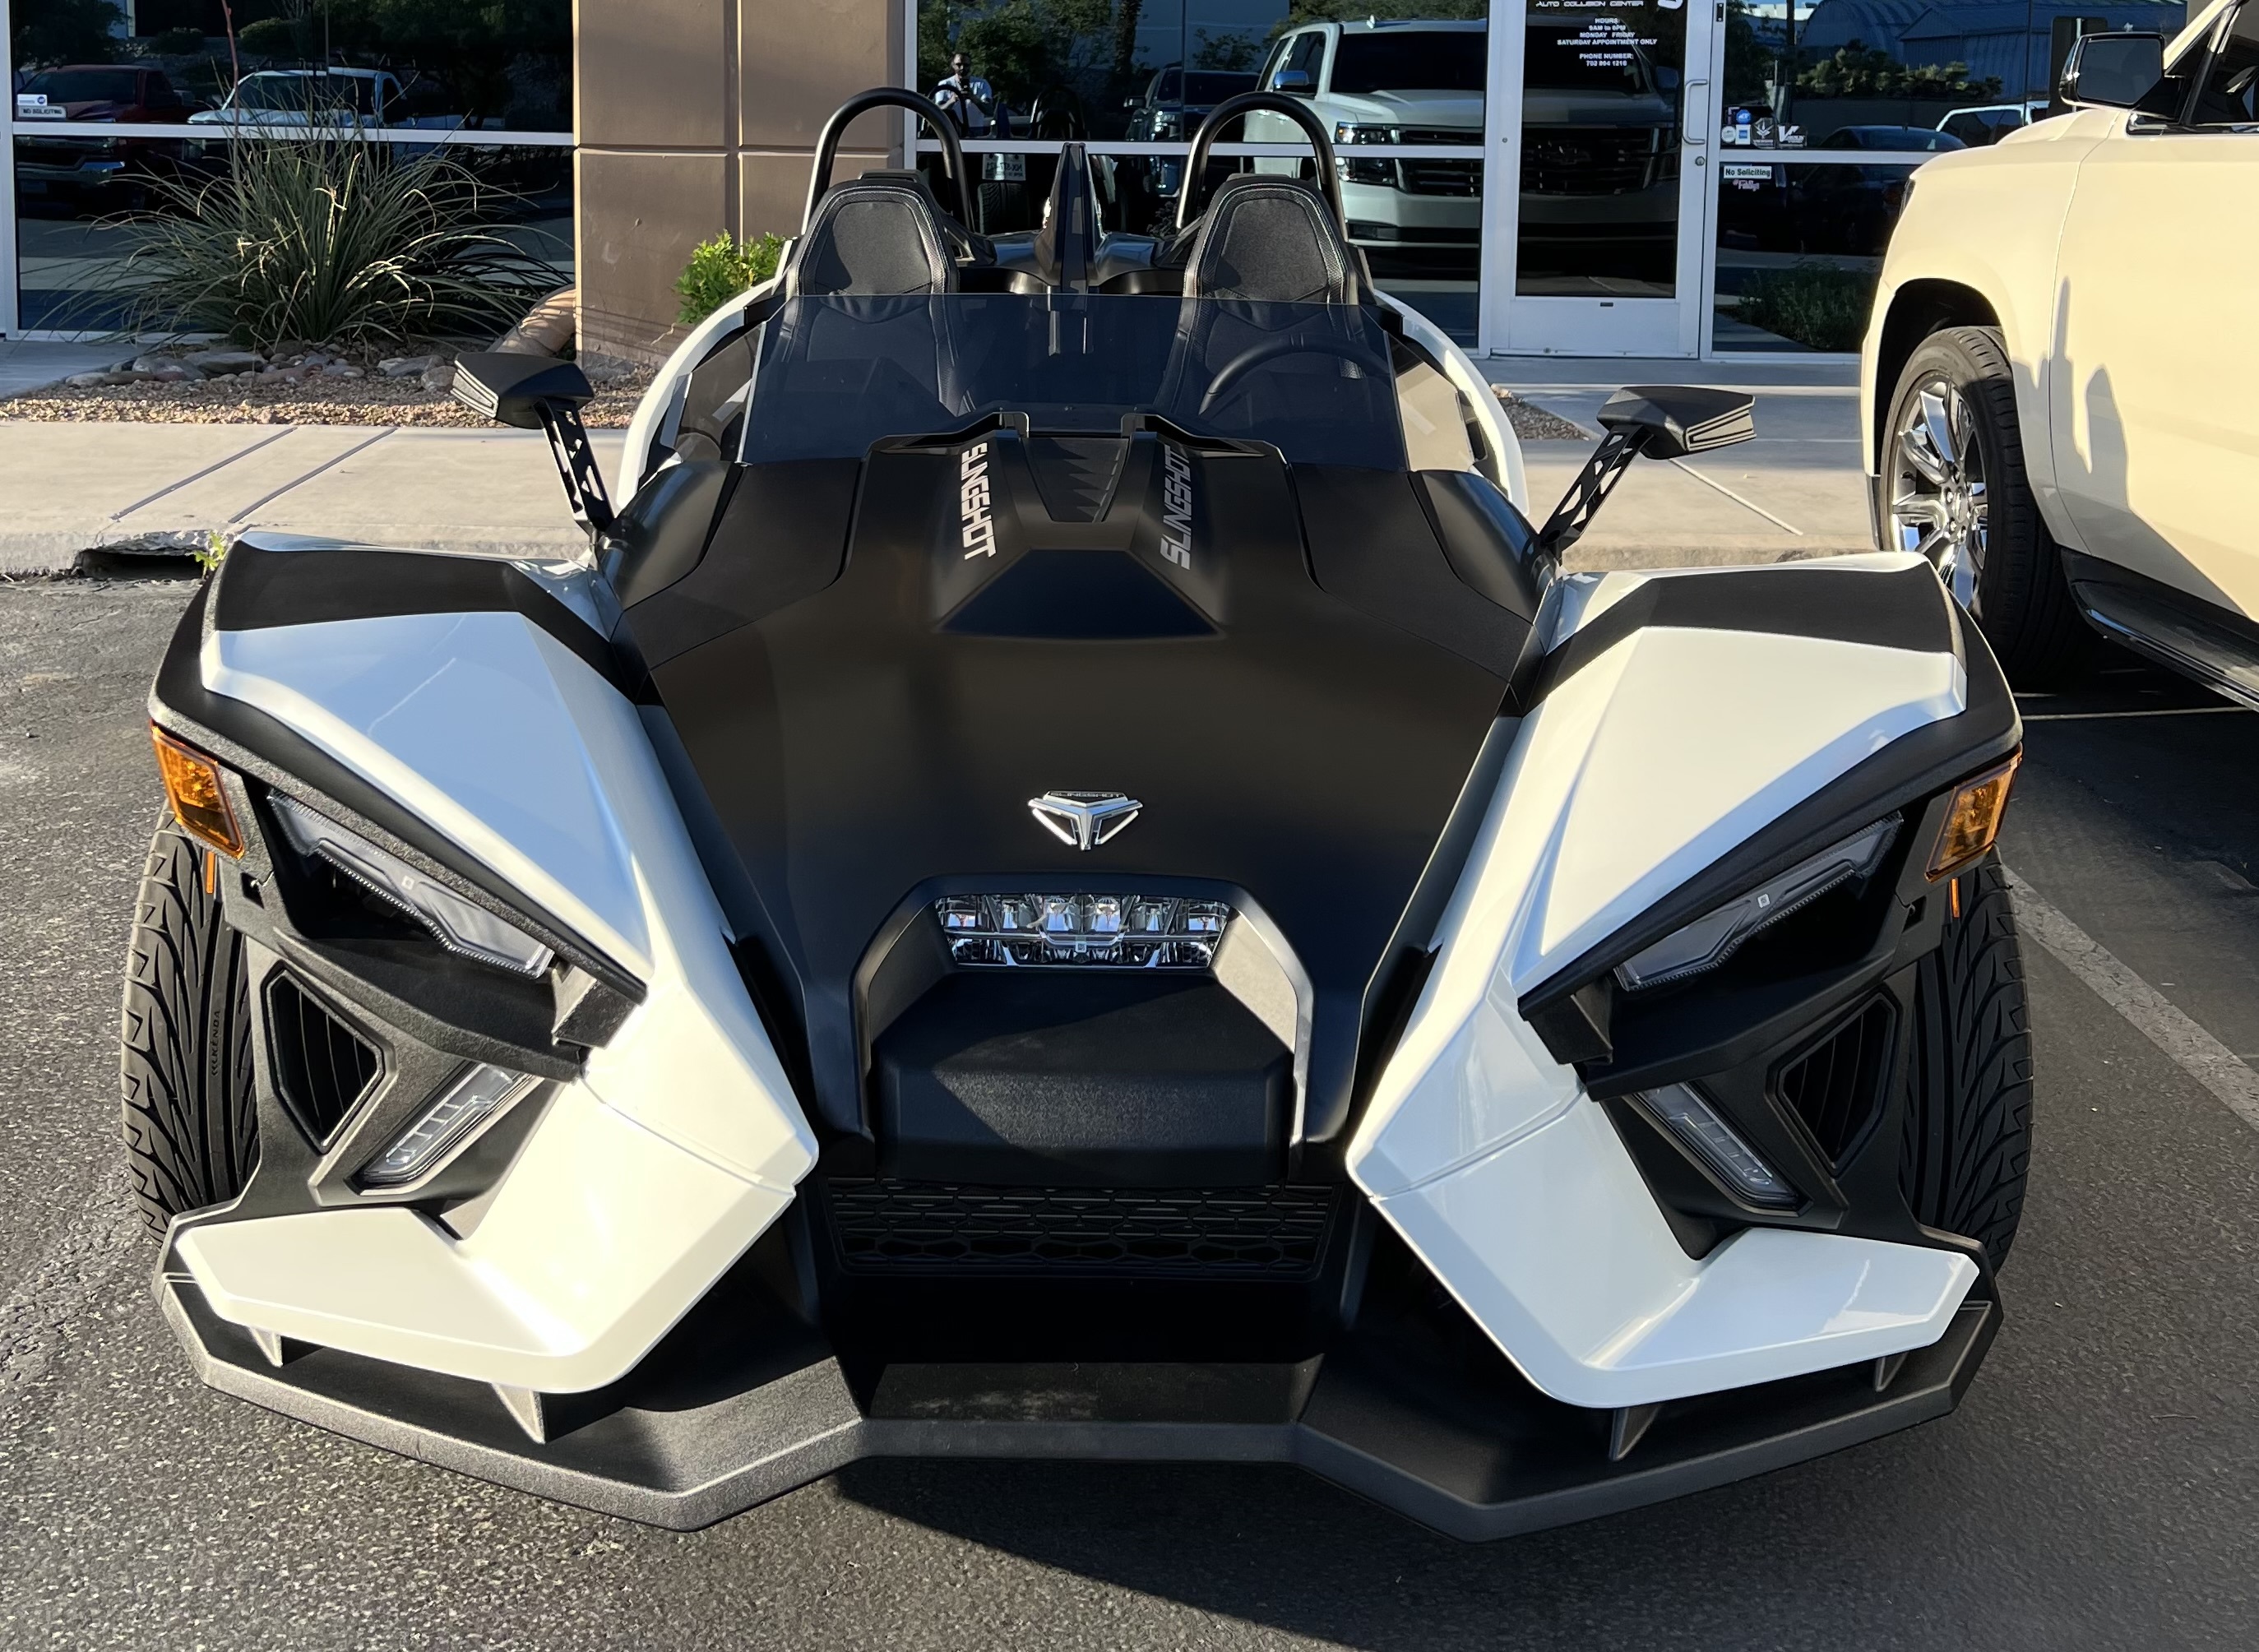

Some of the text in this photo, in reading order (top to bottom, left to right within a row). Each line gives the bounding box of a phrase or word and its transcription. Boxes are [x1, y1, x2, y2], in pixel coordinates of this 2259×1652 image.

[1737, 169, 1771, 177] Soliciting
[961, 443, 997, 561] SLINGSHOT
[1160, 445, 1192, 571] SLINGSHOT
[211, 1011, 221, 1057] KENDA
